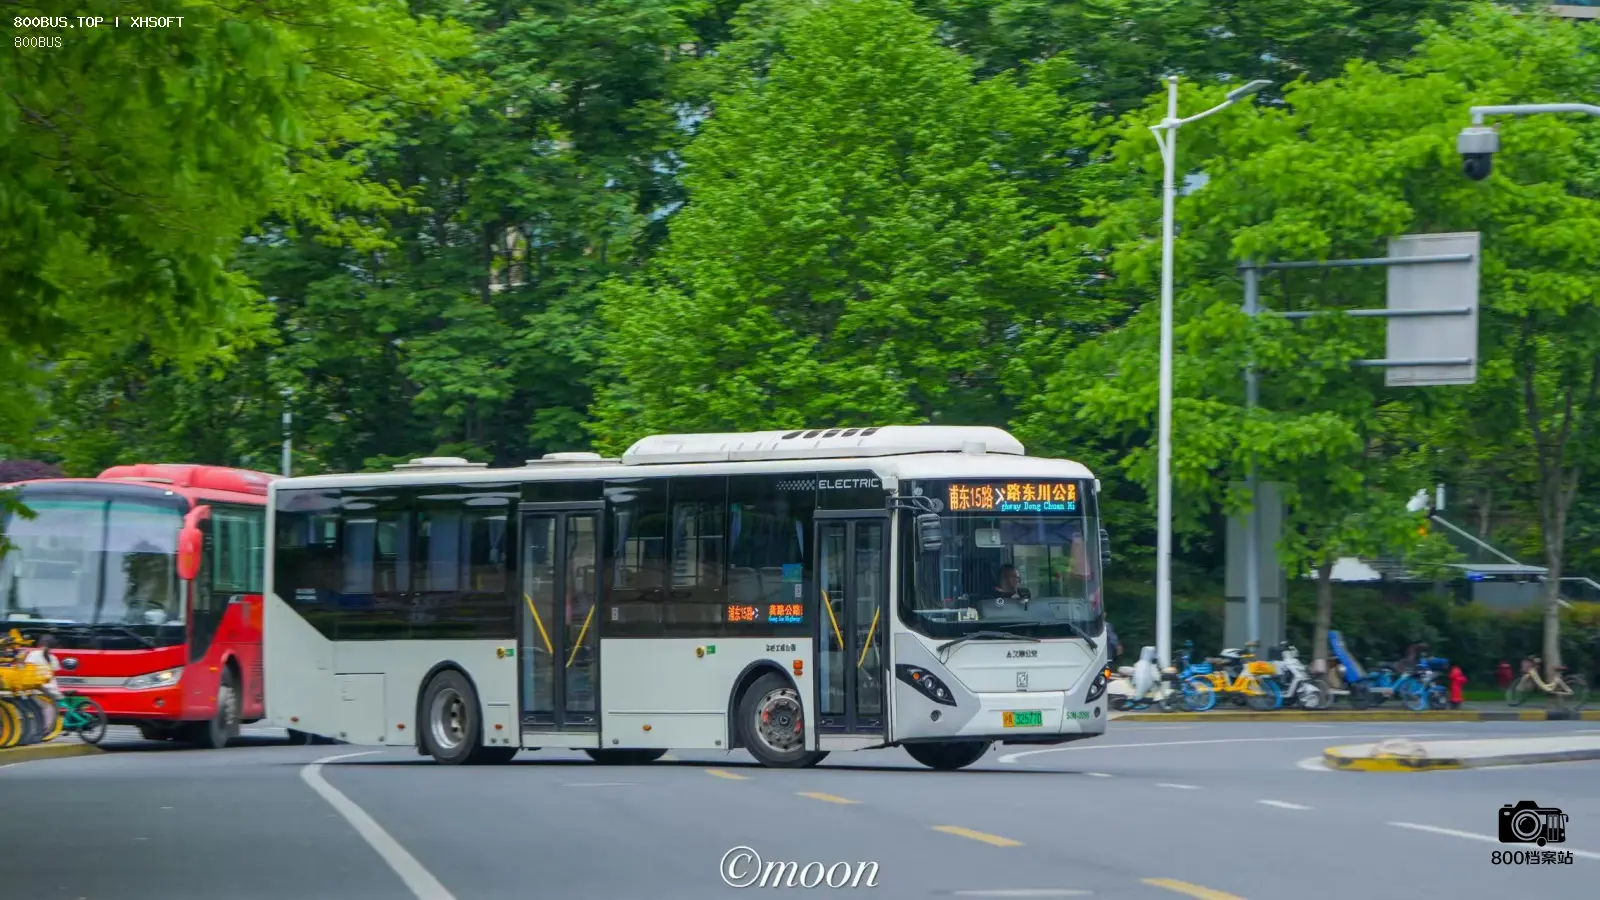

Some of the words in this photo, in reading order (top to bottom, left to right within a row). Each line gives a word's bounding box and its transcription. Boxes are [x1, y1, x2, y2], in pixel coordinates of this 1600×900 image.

[818, 478, 880, 489] ELECTRIC
[1024, 501, 1042, 512] Dong
[1043, 501, 1065, 510] Chuan
